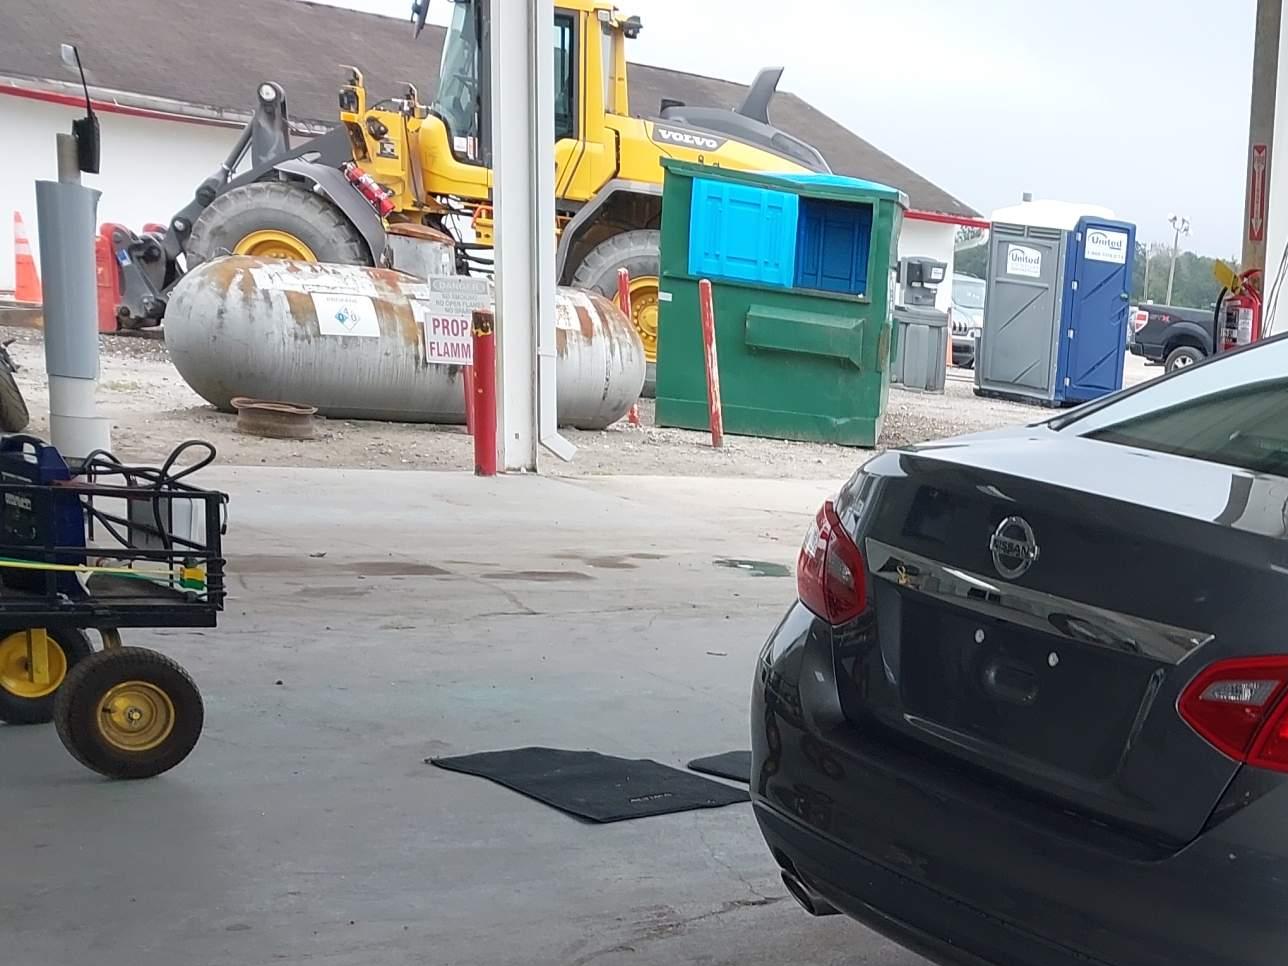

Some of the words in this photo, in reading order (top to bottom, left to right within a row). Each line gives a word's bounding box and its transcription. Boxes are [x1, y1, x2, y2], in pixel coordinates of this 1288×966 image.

[658, 129, 718, 149] VOLVO
[1091, 235, 1122, 248] United
[1011, 252, 1040, 265] United
[431, 317, 469, 337] PROP
[429, 341, 471, 359] FLAMM
[993, 537, 1031, 559] NISSAN
